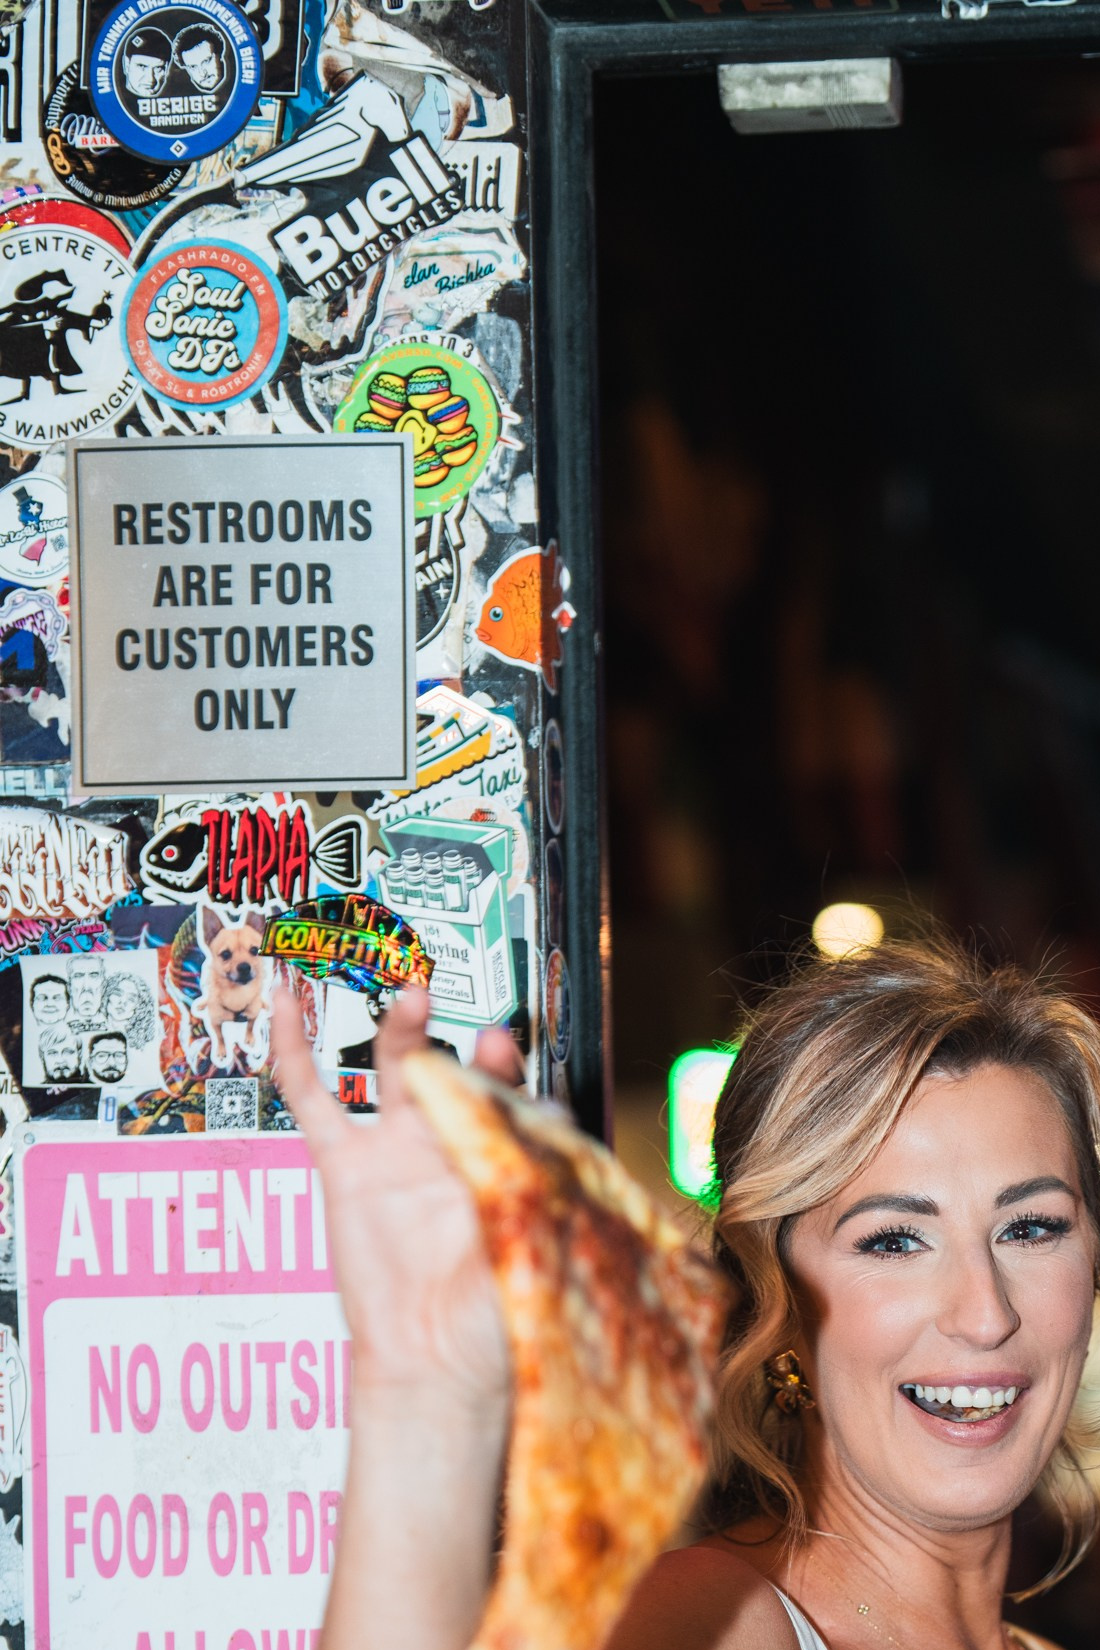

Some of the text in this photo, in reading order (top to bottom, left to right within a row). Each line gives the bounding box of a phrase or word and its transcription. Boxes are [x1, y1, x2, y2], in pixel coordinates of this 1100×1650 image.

[98, 6, 138, 62] TRINKEN
[170, 0, 249, 46] UMENDE
[97, 67, 112, 94] WIR
[137, 95, 217, 116] BIERIGE
[149, 113, 205, 127] BANDITEN
[274, 136, 450, 285] Buell
[2, 236, 125, 280] CENTRE 17
[307, 190, 461, 300] MOTORCYCLES
[167, 268, 246, 311] Soul
[145, 296, 237, 340] Sonic
[113, 499, 373, 546] RESTROOMS
[153, 562, 333, 608] ARE FOR
[115, 623, 375, 671] CUSTOMERS
[194, 688, 297, 732] ONLY
[458, 758, 523, 797] Taxi
[88, 1343, 161, 1434] NO
[64, 1493, 190, 1579] FOOD
[206, 1492, 269, 1577] OR
